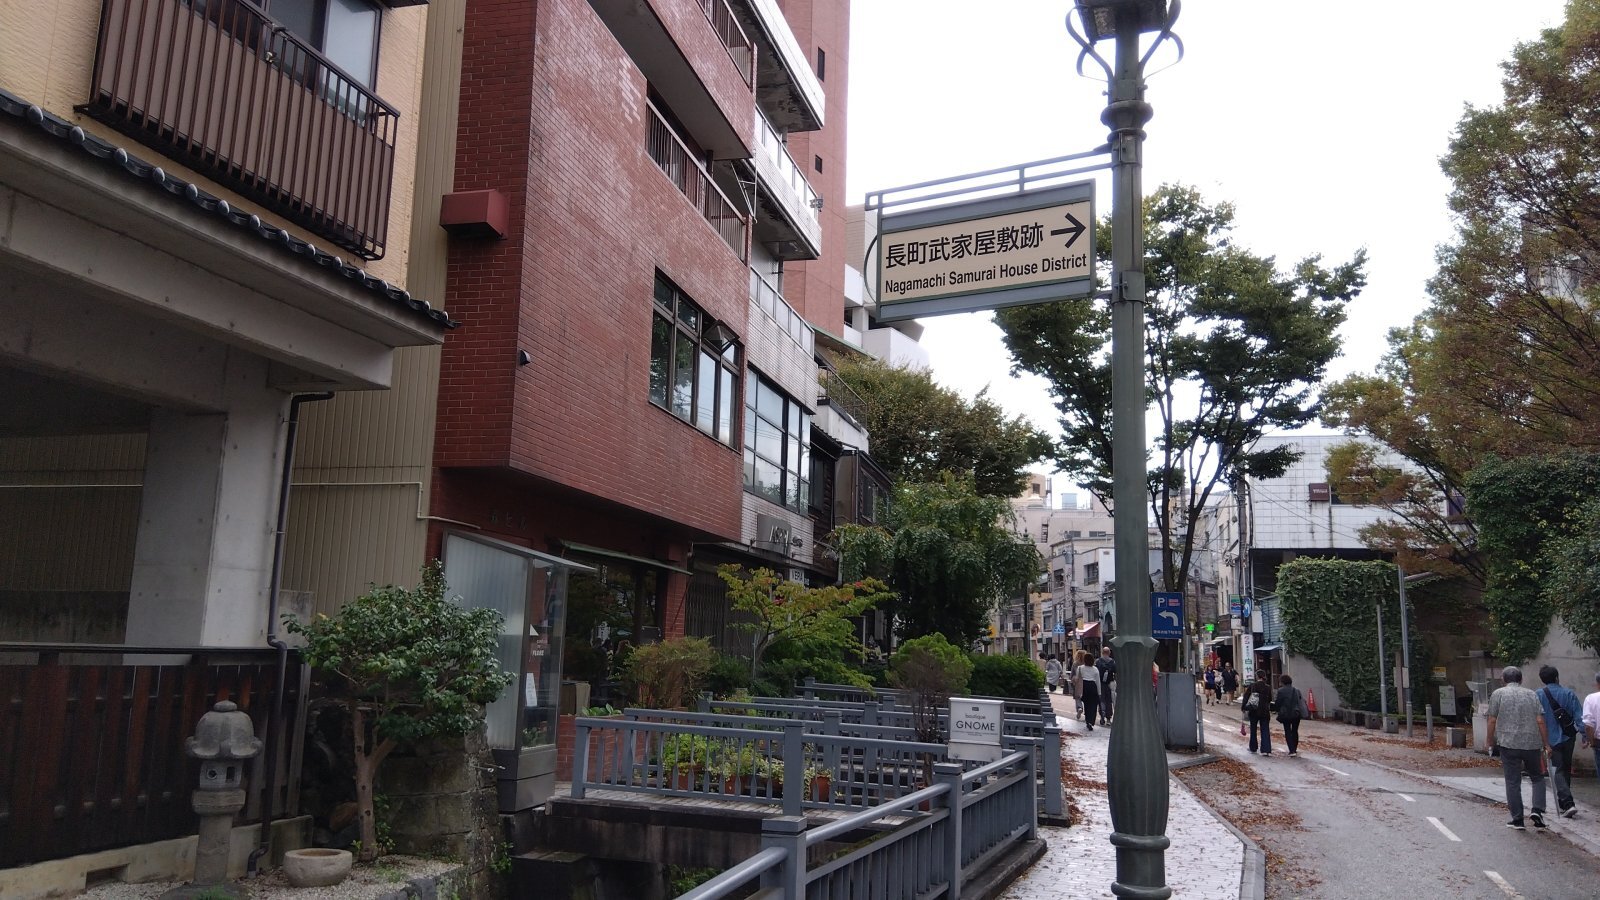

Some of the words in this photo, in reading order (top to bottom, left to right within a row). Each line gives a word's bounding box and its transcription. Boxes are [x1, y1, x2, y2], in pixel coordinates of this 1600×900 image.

[885, 222, 1044, 269] 長町武家屋敷跡
[885, 272, 946, 294] Nagamachi
[949, 266, 996, 285] Samurai
[1000, 263, 1038, 279] House
[1042, 253, 1087, 272] District
[1157, 597, 1166, 608] P
[956, 720, 995, 731] GNOME
